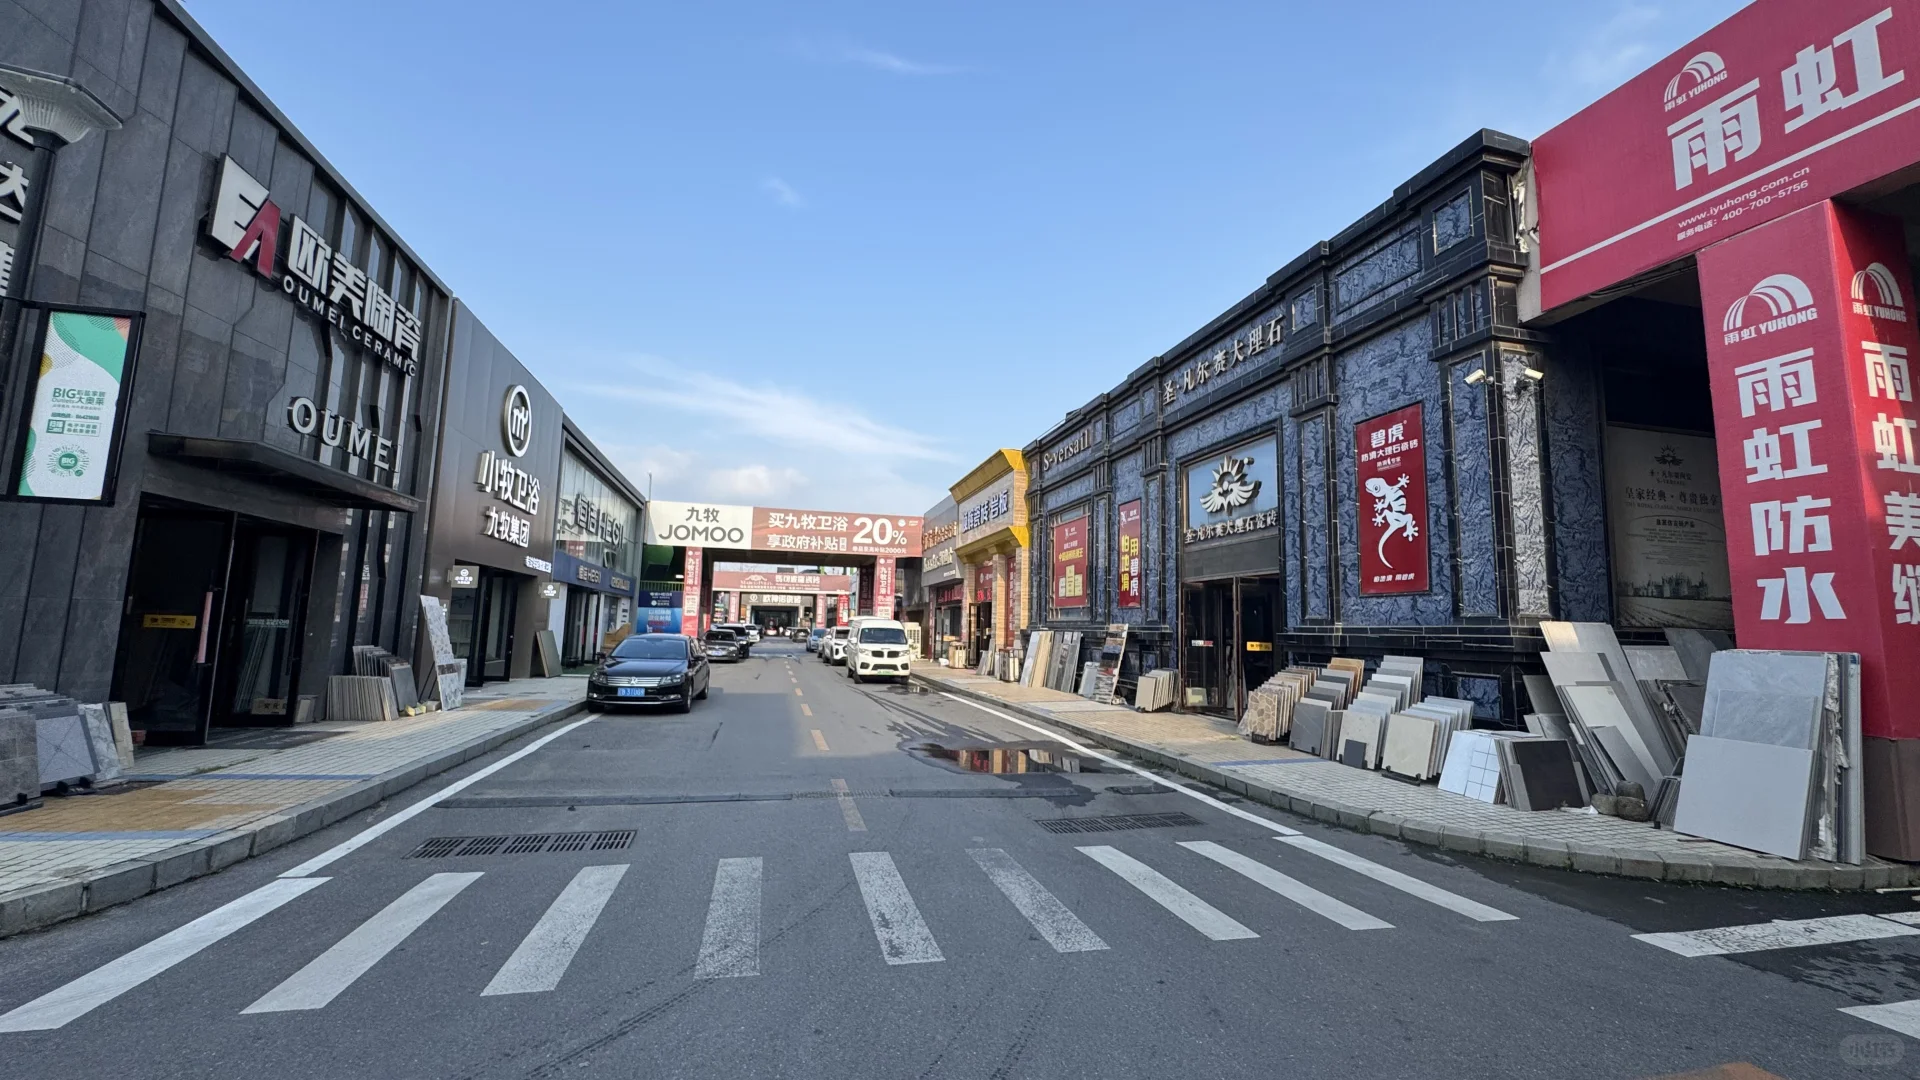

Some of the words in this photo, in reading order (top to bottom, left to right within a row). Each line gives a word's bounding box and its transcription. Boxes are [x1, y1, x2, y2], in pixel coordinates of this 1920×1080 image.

[1664, 95, 1688, 112] 雨虹
[1688, 70, 1728, 98] YUHONG
[1667, 7, 1905, 191] 雨虹
[1678, 167, 1810, 229] www.iyuhong.com.cn
[288, 215, 422, 362] 欧美陶瓷
[283, 275, 345, 329] OUMEI
[352, 325, 416, 377] CERAMIC
[1724, 325, 1757, 346] 雨虹
[1759, 307, 1818, 336] YUHONG
[1852, 301, 1874, 317] 雨虹
[1874, 305, 1907, 323] YUHONG
[53, 388, 76, 399] BIG
[1371, 422, 1404, 448] 碧虎
[478, 450, 541, 516] 小牧卫浴
[1734, 347, 1846, 624] 雨虹防水
[485, 506, 530, 548] 九牧集团
[659, 524, 744, 543] JOMOO
[686, 507, 720, 523] 九牧
[768, 512, 848, 532] 买九牧卫浴
[852, 517, 908, 545] 20%
[766, 534, 838, 551] 享政府补贴
[1130, 538, 1138, 596] 用碧虎
